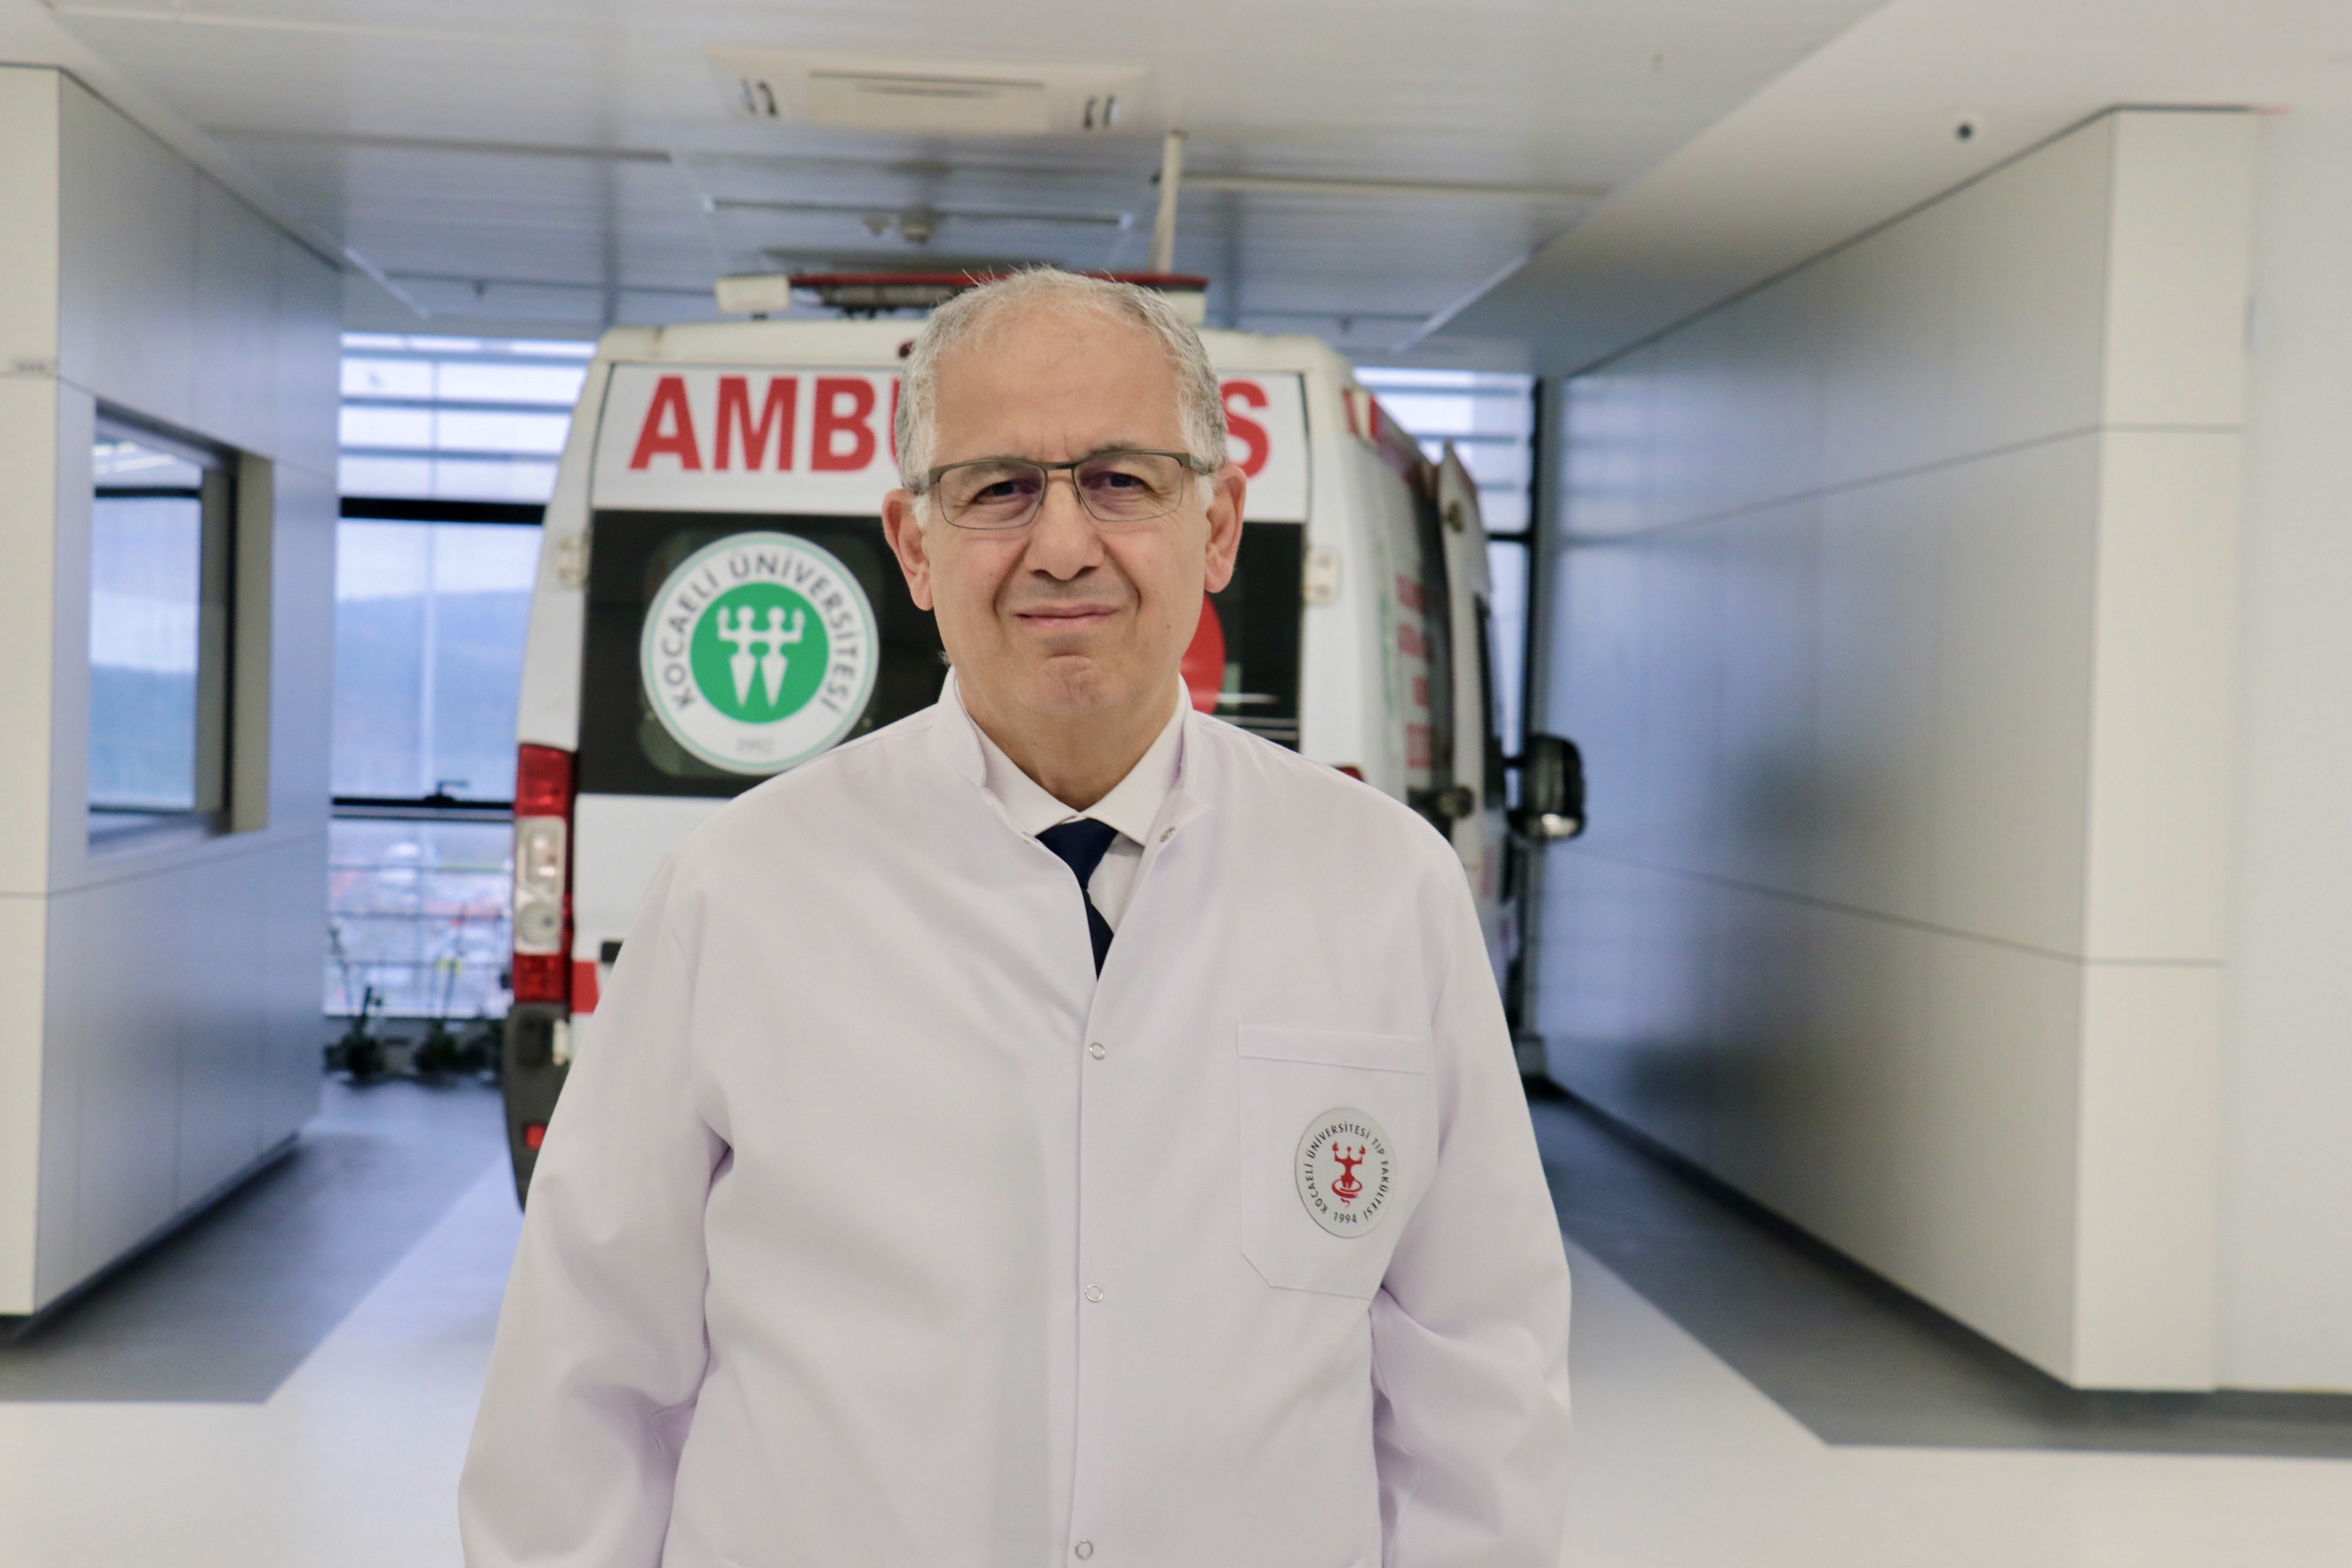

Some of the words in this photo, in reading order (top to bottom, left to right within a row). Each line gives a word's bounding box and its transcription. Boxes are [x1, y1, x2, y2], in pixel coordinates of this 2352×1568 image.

[628, 374, 1269, 479] AMBS
[1305, 1121, 1371, 1159] ÜNİVERSİTESİ
[1371, 1138, 1385, 1156] TIP
[1304, 1162, 1328, 1214] KOCAELİ
[1363, 1161, 1389, 1221] FAKÜLTESİ
[1334, 1212, 1357, 1224] 1994
